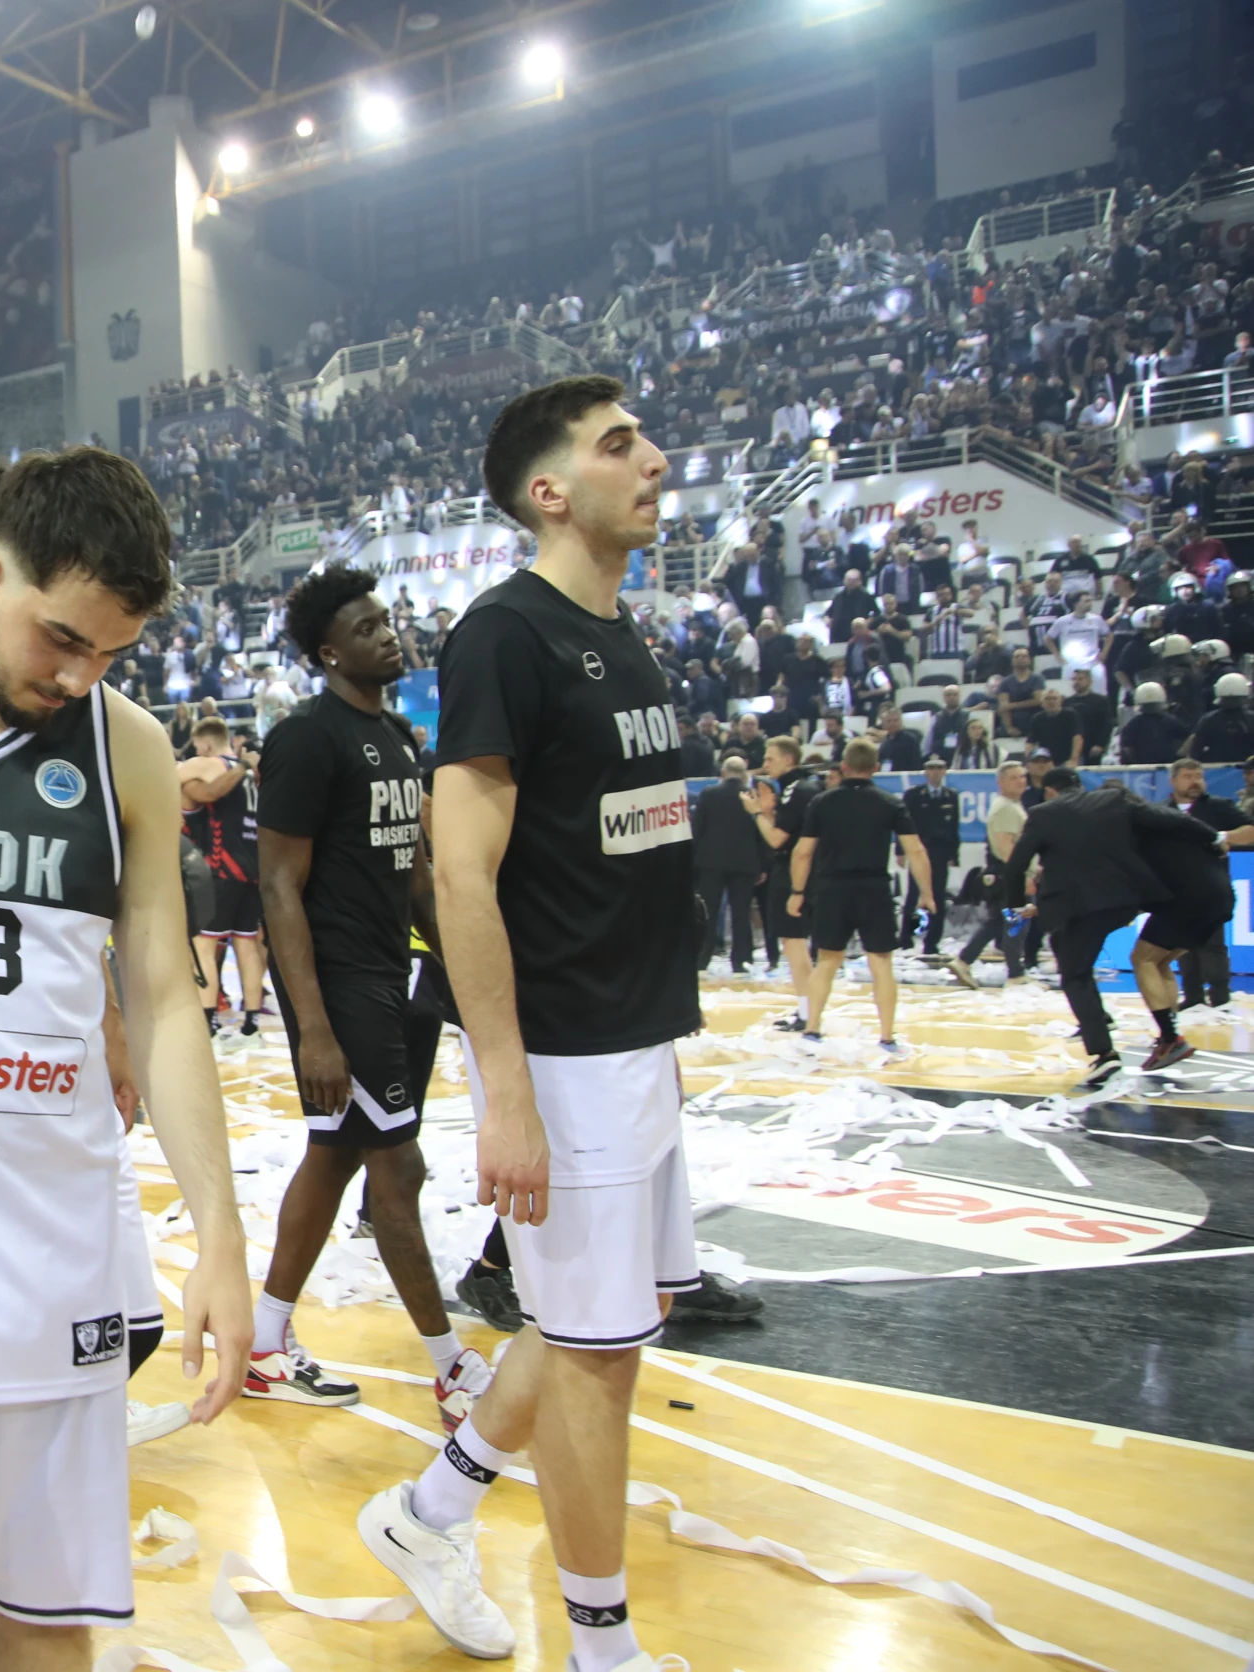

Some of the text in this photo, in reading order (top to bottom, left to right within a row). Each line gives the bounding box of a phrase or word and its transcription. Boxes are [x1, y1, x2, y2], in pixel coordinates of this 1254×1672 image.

[748, 310, 814, 339] SPORTS
[817, 298, 879, 325] ARENA
[605, 794, 690, 839] winmast
[447, 1443, 485, 1482] GSA
